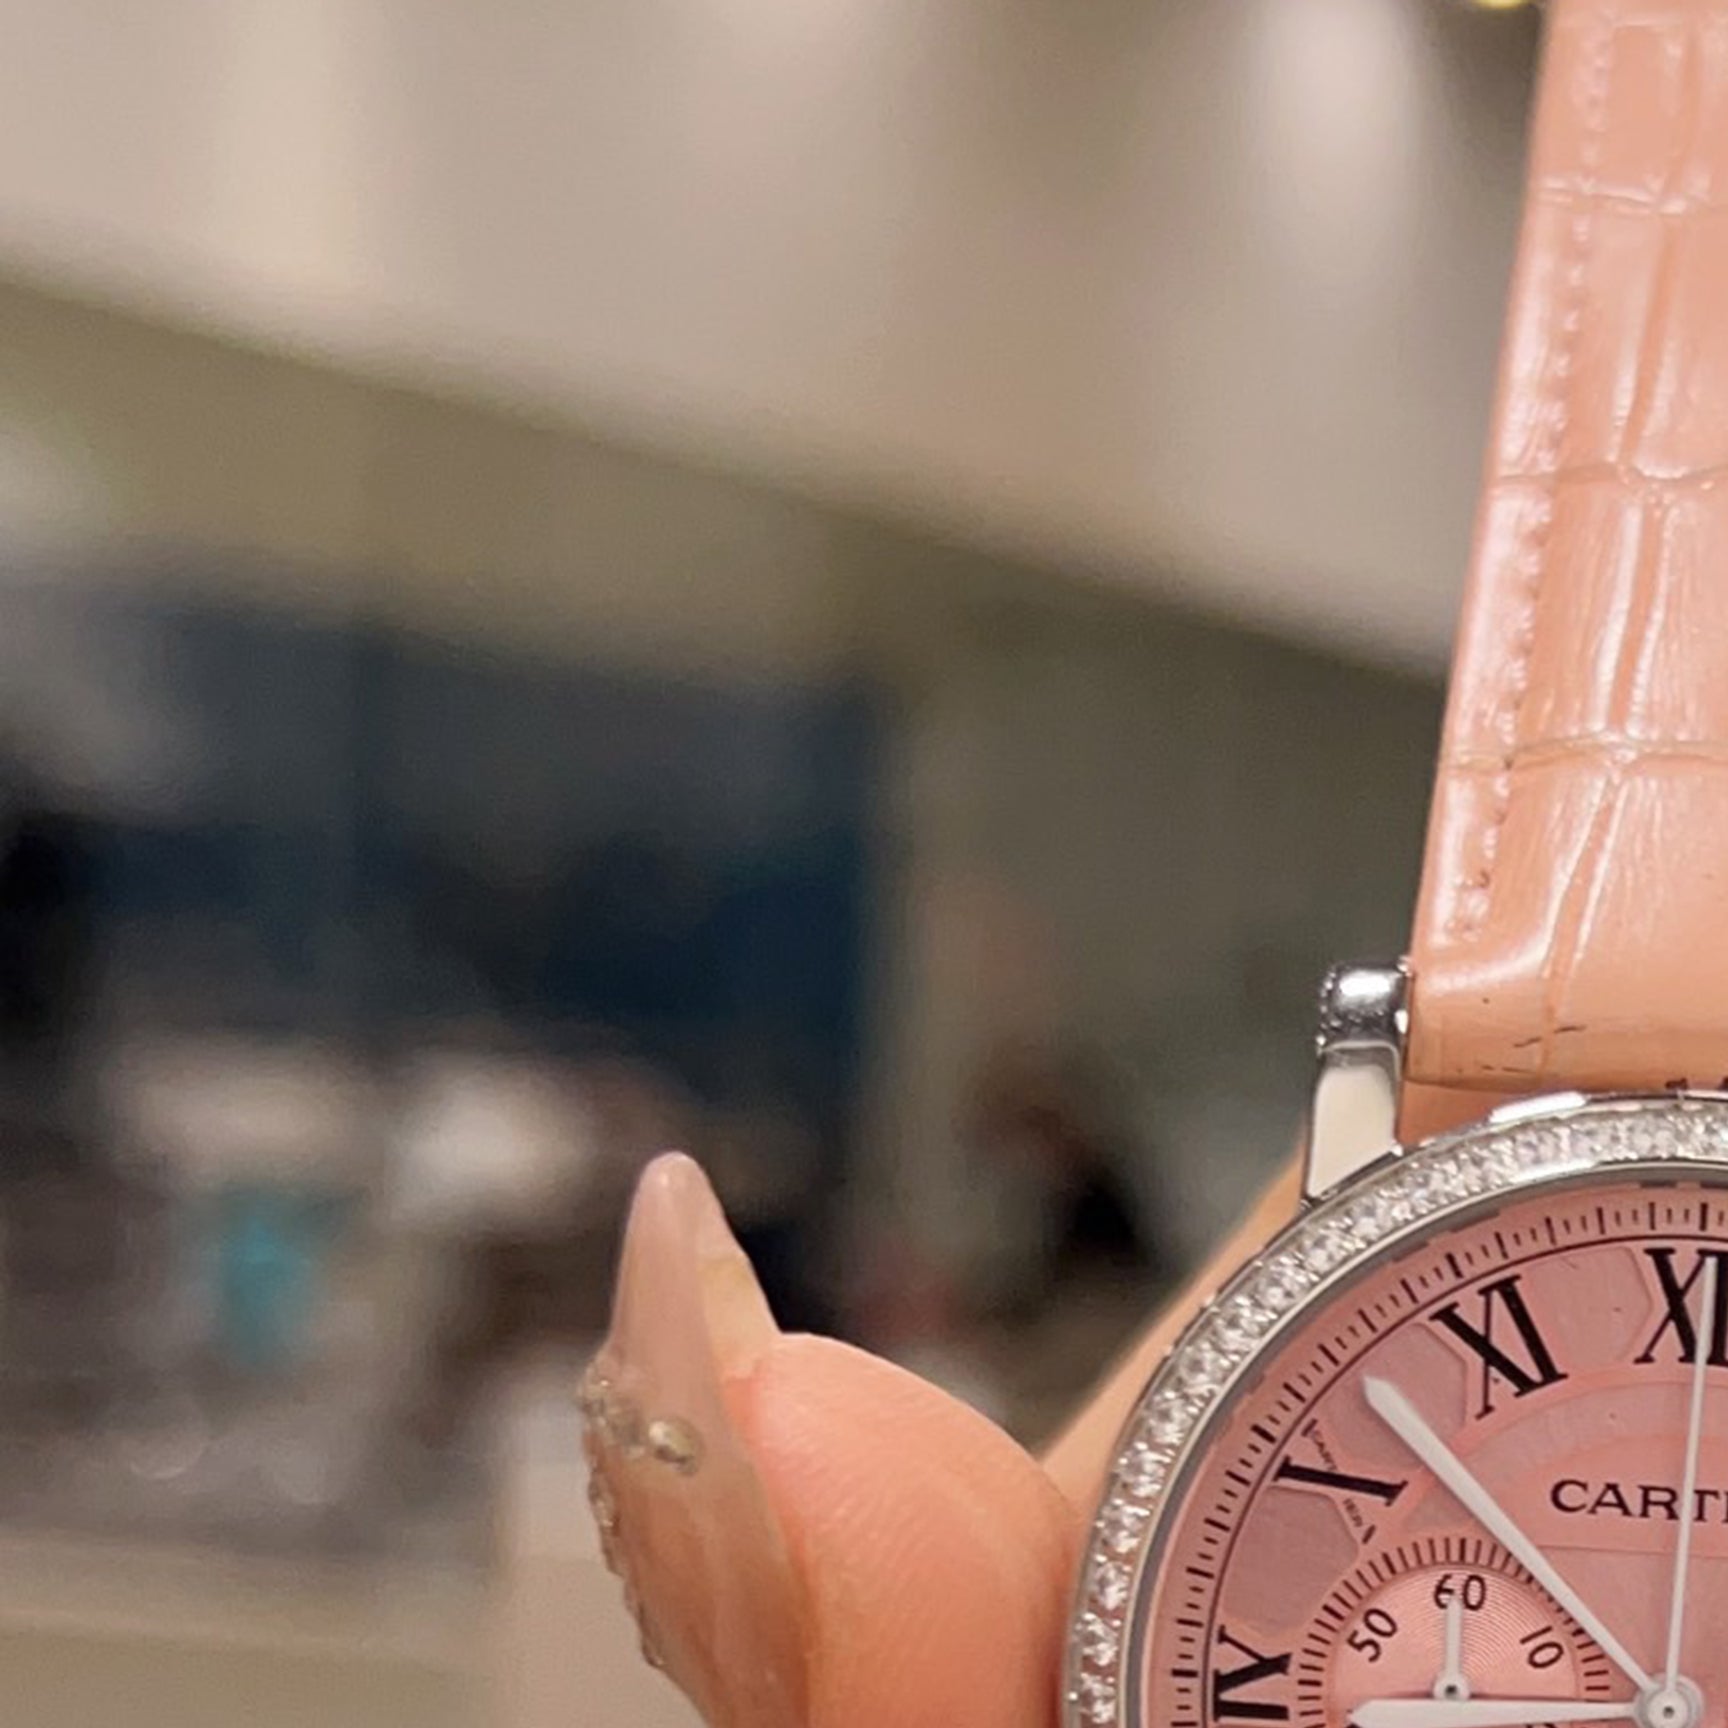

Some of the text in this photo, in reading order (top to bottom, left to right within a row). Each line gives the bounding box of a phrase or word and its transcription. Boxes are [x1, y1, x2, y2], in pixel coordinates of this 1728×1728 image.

[1429, 1274, 1567, 1420] XI
[1434, 1574, 1486, 1611] 60
[1347, 1608, 1398, 1663] 50
[1520, 1626, 1564, 1669] 10
